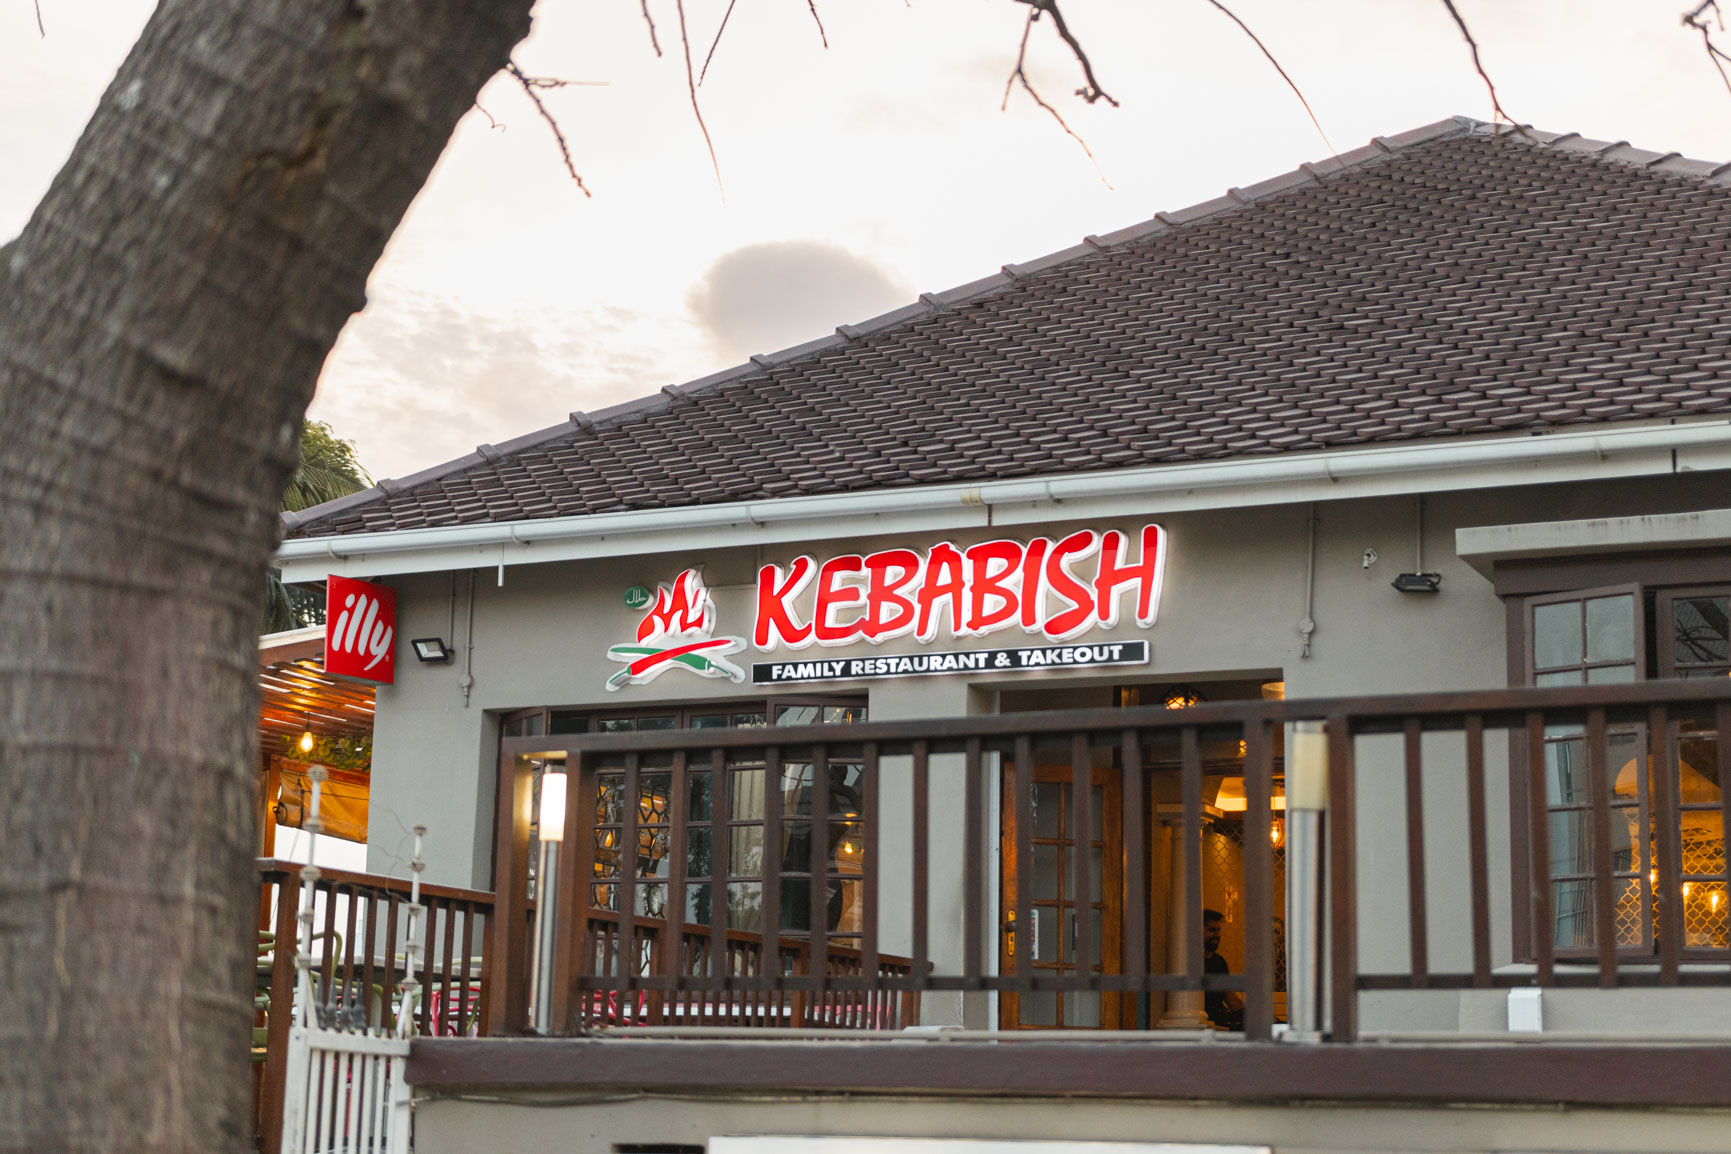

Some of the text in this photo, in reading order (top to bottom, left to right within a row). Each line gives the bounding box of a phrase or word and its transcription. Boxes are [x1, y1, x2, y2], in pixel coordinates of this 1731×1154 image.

[753, 524, 1163, 651] KEBABISH
[331, 593, 393, 671] illy
[771, 645, 1123, 680] FAMILY RESTAURANT & TAKEOUT
